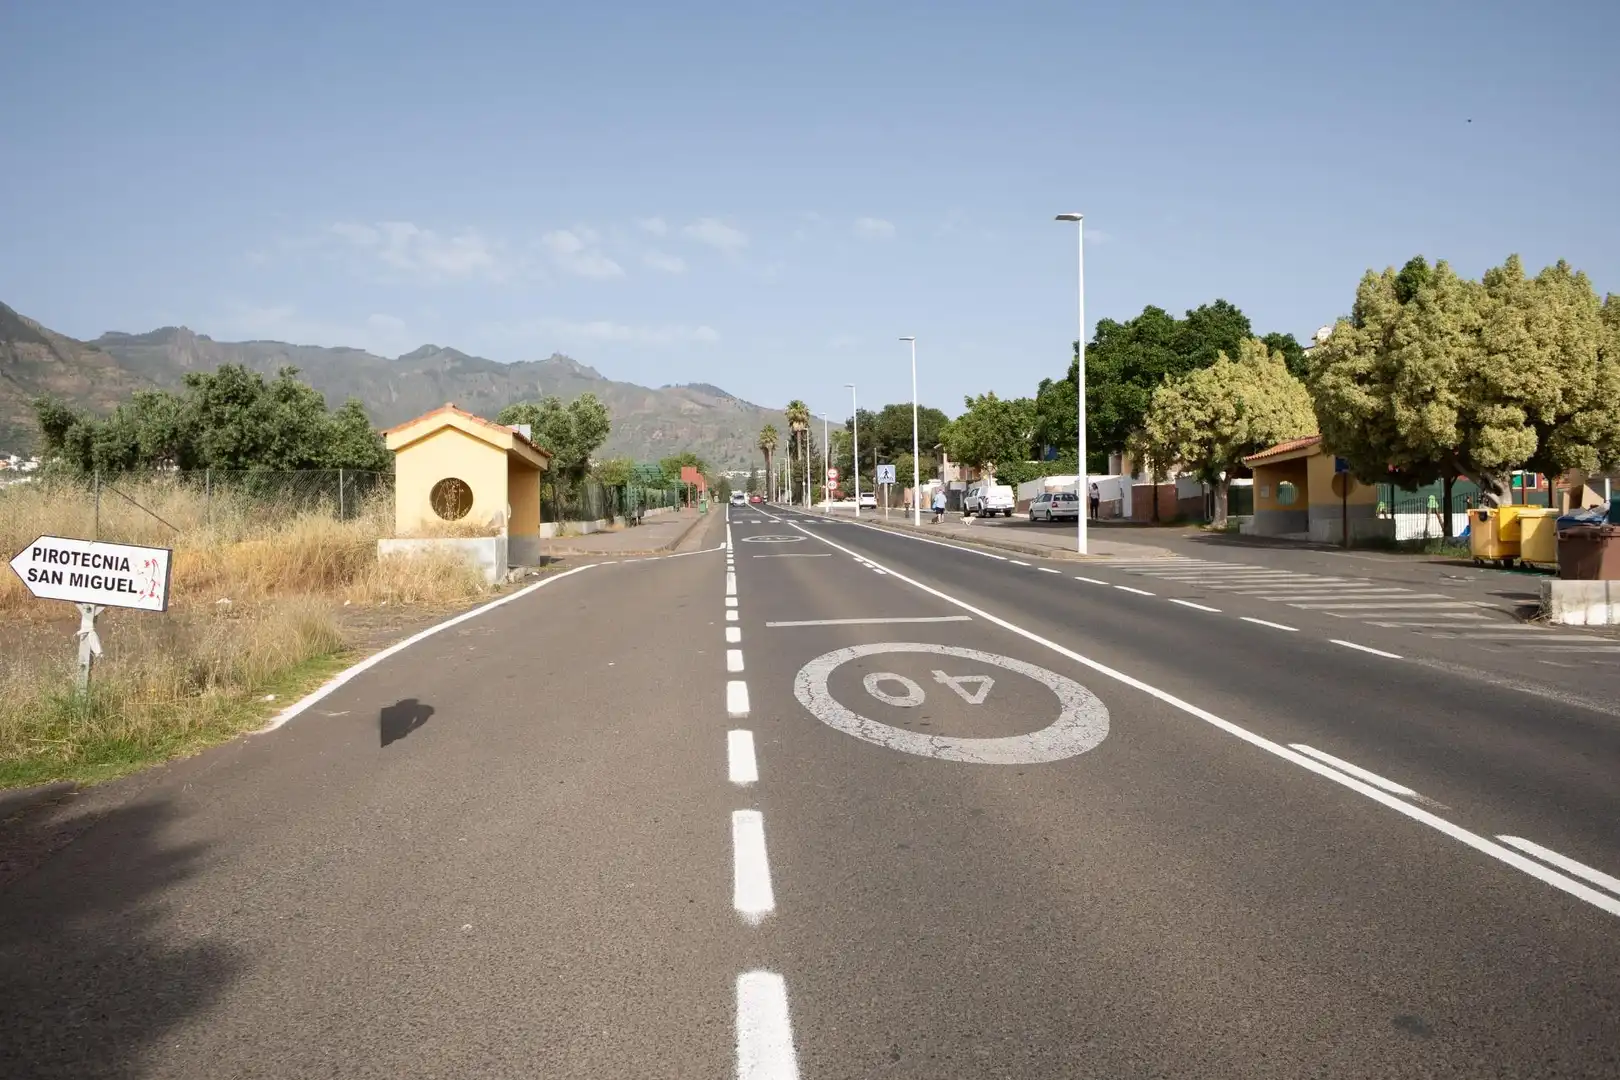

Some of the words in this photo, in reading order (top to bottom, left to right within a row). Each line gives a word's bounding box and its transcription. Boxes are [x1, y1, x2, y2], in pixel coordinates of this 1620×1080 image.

[32, 547, 130, 572] PIROTECNIA
[27, 568, 63, 585] SAN
[69, 572, 138, 594] MIGUEL
[862, 670, 995, 707] 40
